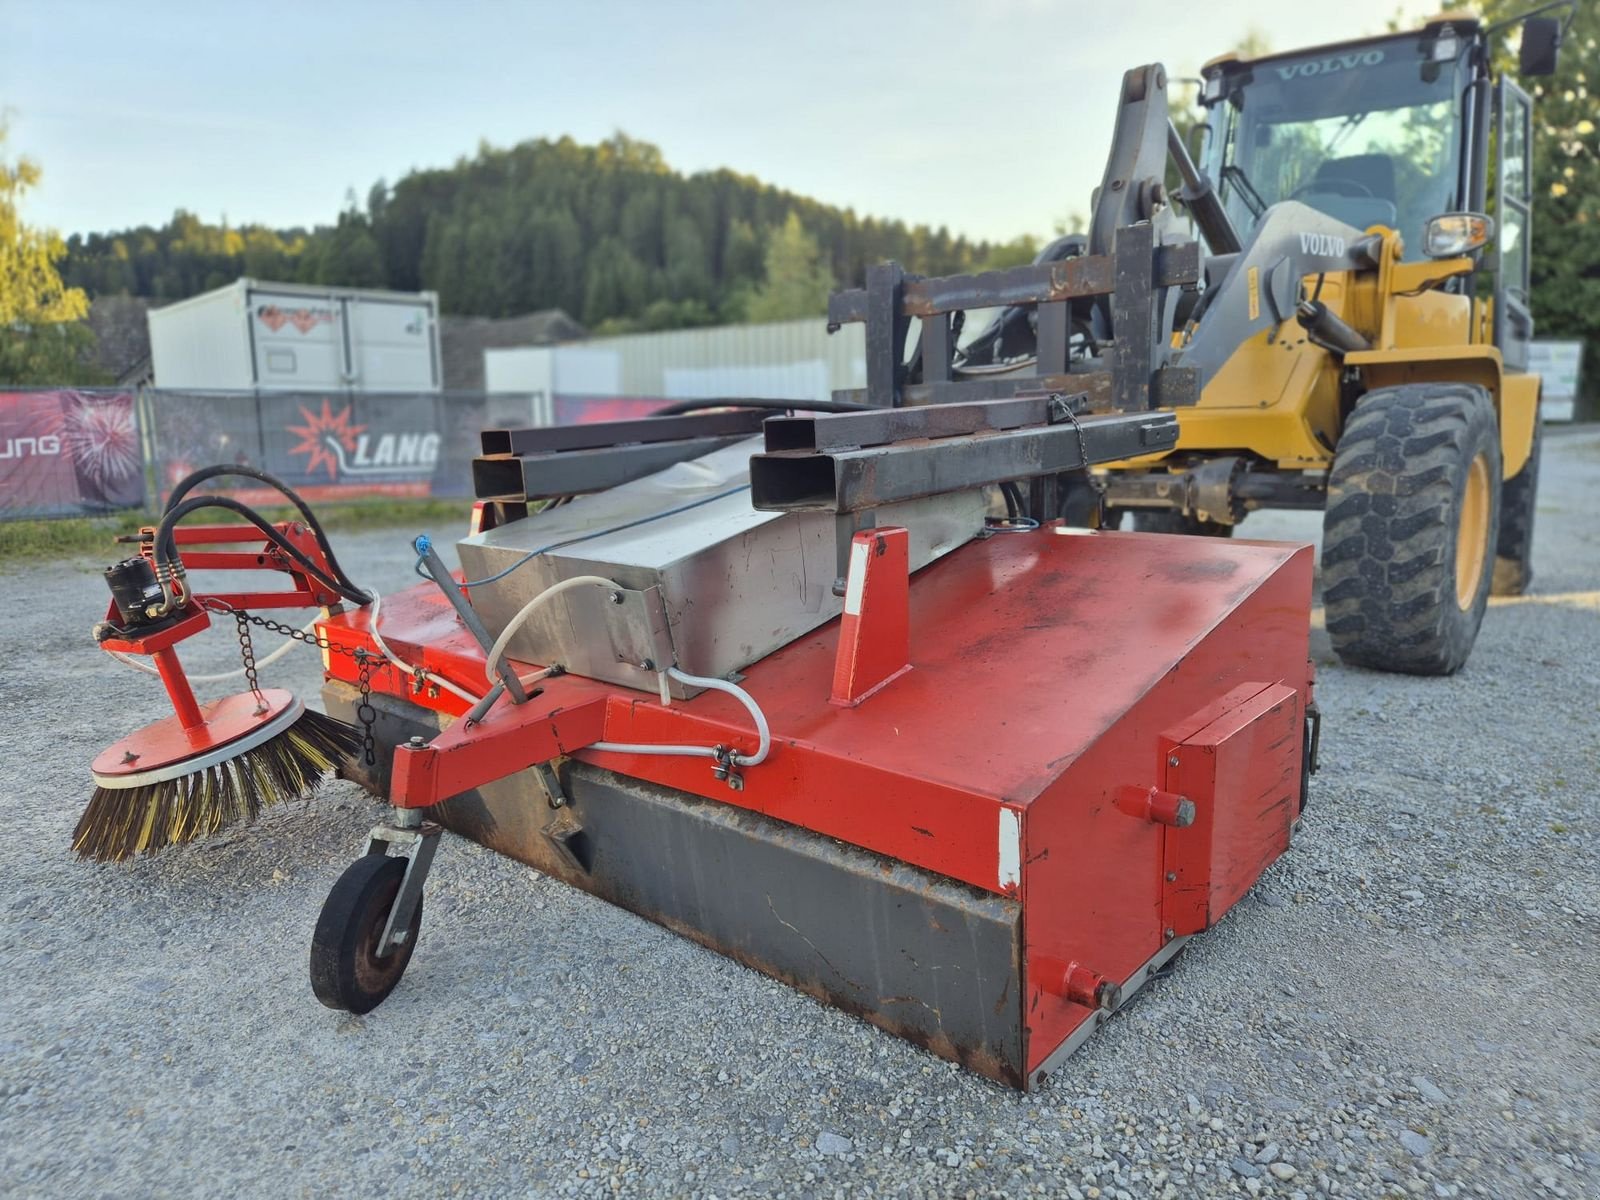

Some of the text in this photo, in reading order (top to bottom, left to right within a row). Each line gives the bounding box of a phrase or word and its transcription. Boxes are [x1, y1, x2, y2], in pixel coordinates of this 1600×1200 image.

[1276, 51, 1385, 80] VOLVO
[1300, 232, 1345, 258] VOLVO
[354, 432, 441, 466] LANG
